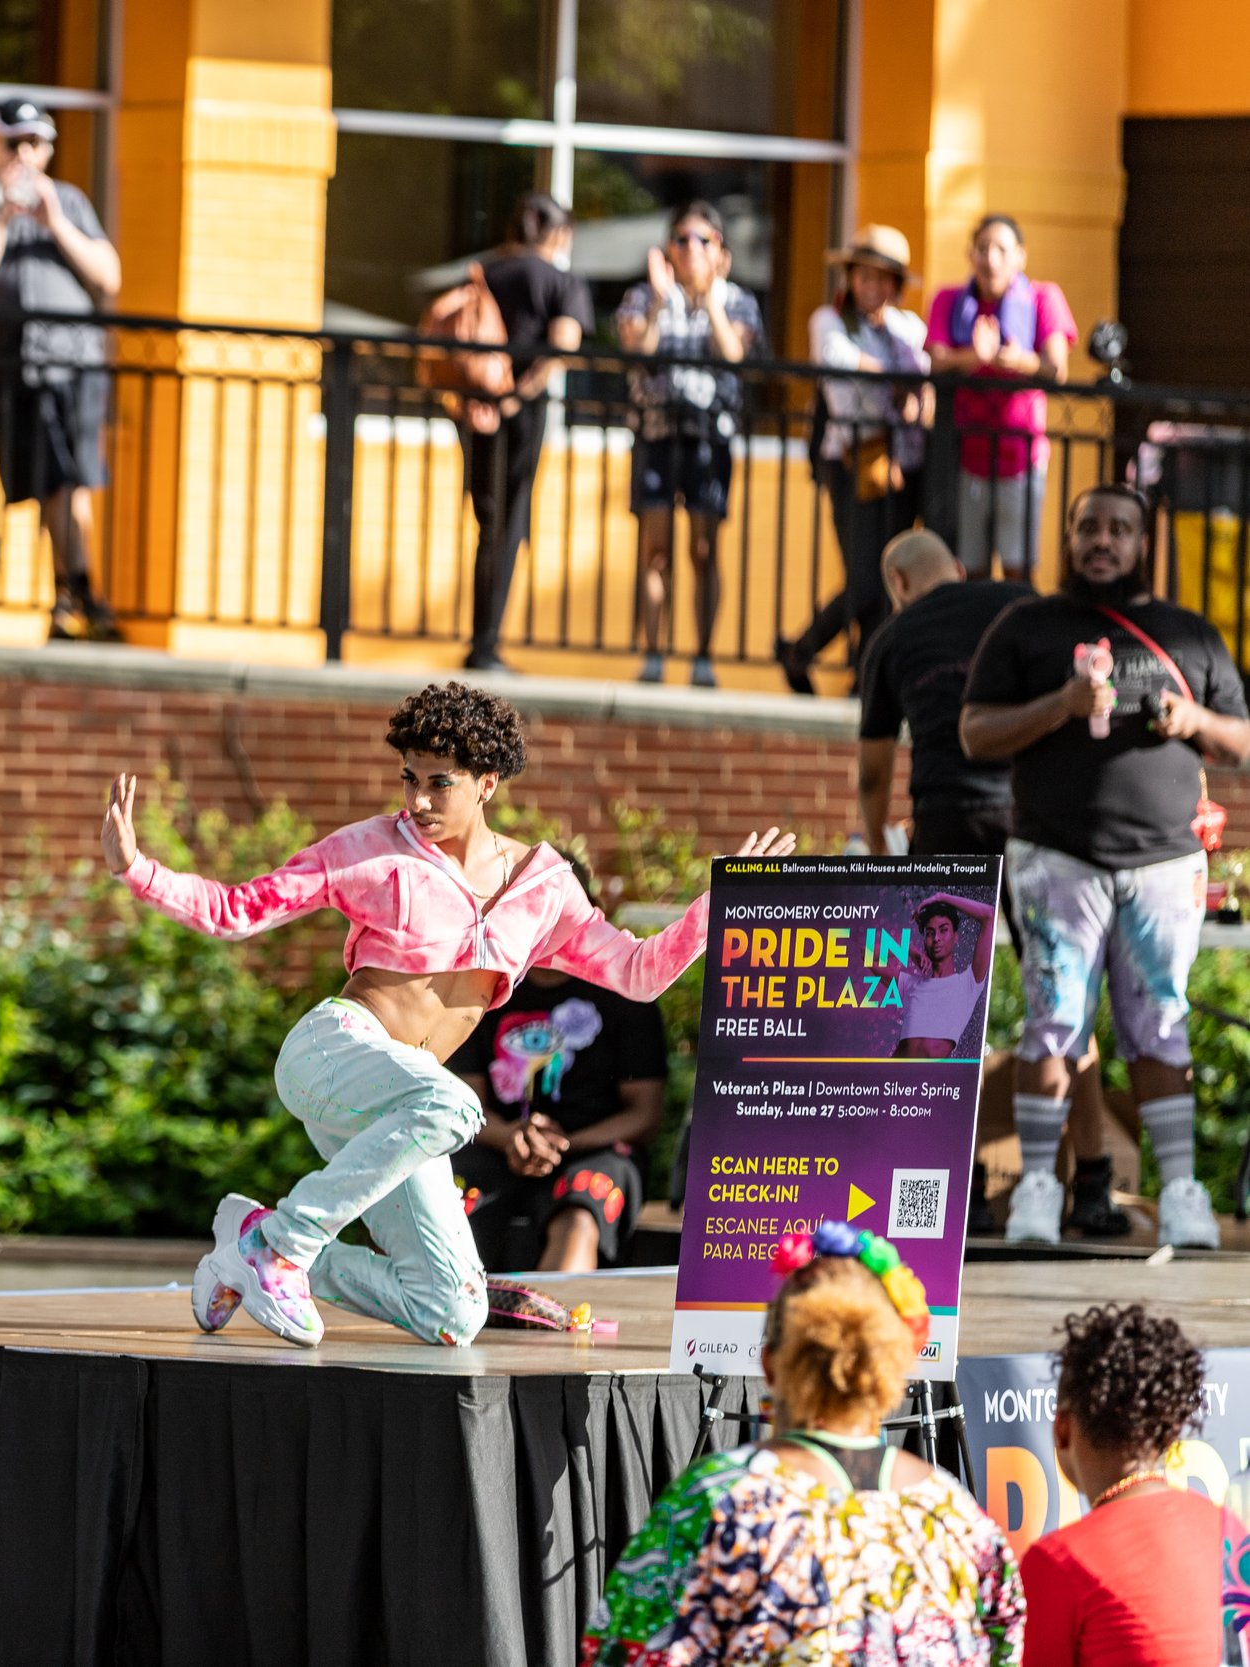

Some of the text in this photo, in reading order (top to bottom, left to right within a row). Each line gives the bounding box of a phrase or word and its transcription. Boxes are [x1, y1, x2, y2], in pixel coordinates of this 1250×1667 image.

[725, 863, 986, 874] CALLING ALL Ballroom Houses, Kiki Houses and Modeling Troupes!
[725, 905, 879, 919] MONTGOMERY COUNTY
[721, 928, 911, 968] PRIDE IN
[720, 976, 903, 1009] THE PLAZA
[715, 1018, 807, 1037] FREE BALL
[713, 1080, 769, 1095] Veteran's
[772, 1080, 805, 1095] Plaza
[815, 1081, 880, 1096] Downtown
[883, 1081, 917, 1096] Silver
[921, 1082, 960, 1100] Spring
[736, 1101, 784, 1119] Sunday,
[786, 1102, 817, 1116] June
[820, 1105, 835, 1118] 27
[837, 1104, 879, 1118] 5:00PM
[890, 1104, 931, 1117] 8:00PM
[710, 1156, 839, 1175] SCAN HERE TO
[708, 1184, 799, 1203] CHECK-IN!
[705, 1217, 778, 1235] ESCANEE
[703, 1242, 743, 1260] PARA
[699, 1343, 738, 1354] GILEAD
